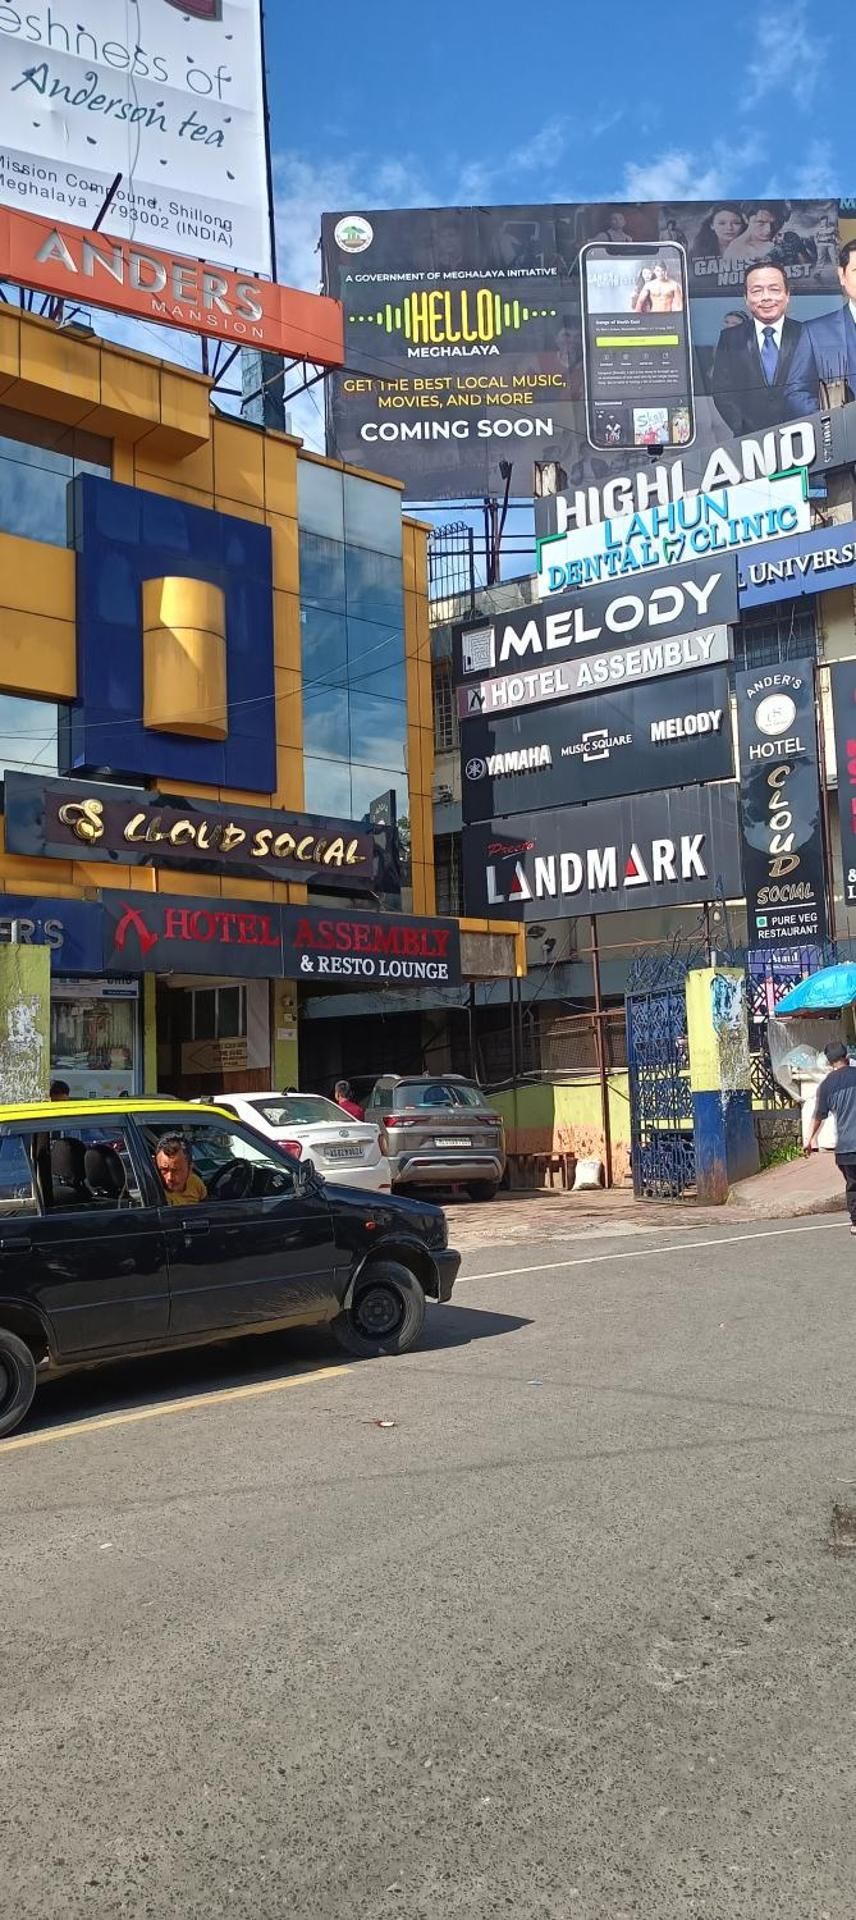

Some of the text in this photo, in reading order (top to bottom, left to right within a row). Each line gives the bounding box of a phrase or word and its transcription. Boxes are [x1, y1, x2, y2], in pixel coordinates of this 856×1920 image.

[186, 65, 227, 100] of
[11, 63, 224, 147] Anderson tea
[109, 202, 169, 230] 793002
[176, 221, 233, 248] (INDIA)
[169, 201, 233, 232] Shillong
[36, 229, 263, 321] ANDERS
[346, 267, 557, 283] A GOVERNMENT OF MEGHALAYA INITIATIVE
[152, 300, 264, 338] MANSION
[411, 288, 493, 343] HELLO
[407, 345, 500, 358] MEGHALAYA
[343, 374, 567, 392] GET THE BEST LOCAL MUSIC,
[378, 392, 534, 409] MOVIES, AND MORE
[360, 418, 553, 442] COMING SOON
[556, 421, 816, 536] HIGHLAND
[604, 489, 729, 549] LAHUN
[548, 504, 798, 592] DENTAL CLINIC
[500, 573, 722, 662] MELODY
[491, 632, 717, 707] HOTEL ASSEMBLY
[746, 674, 802, 699] ANDER'S
[650, 709, 723, 742] MELODY
[485, 745, 552, 776] YAMAHA
[561, 734, 633, 757] MUSIC SQUARE
[749, 737, 806, 760] HOTEL
[767, 765, 801, 878] CLOUD
[123, 812, 366, 867] CLOUD SOCIAL
[486, 834, 707, 904] LANDMARK
[756, 881, 815, 905] SOCIAL
[164, 907, 450, 957] HOTEL ASSEMBLY
[758, 924, 819, 939] RESTAURANT
[771, 912, 818, 926] PURE VEG
[300, 955, 449, 980] & RESTO LOUNGE
